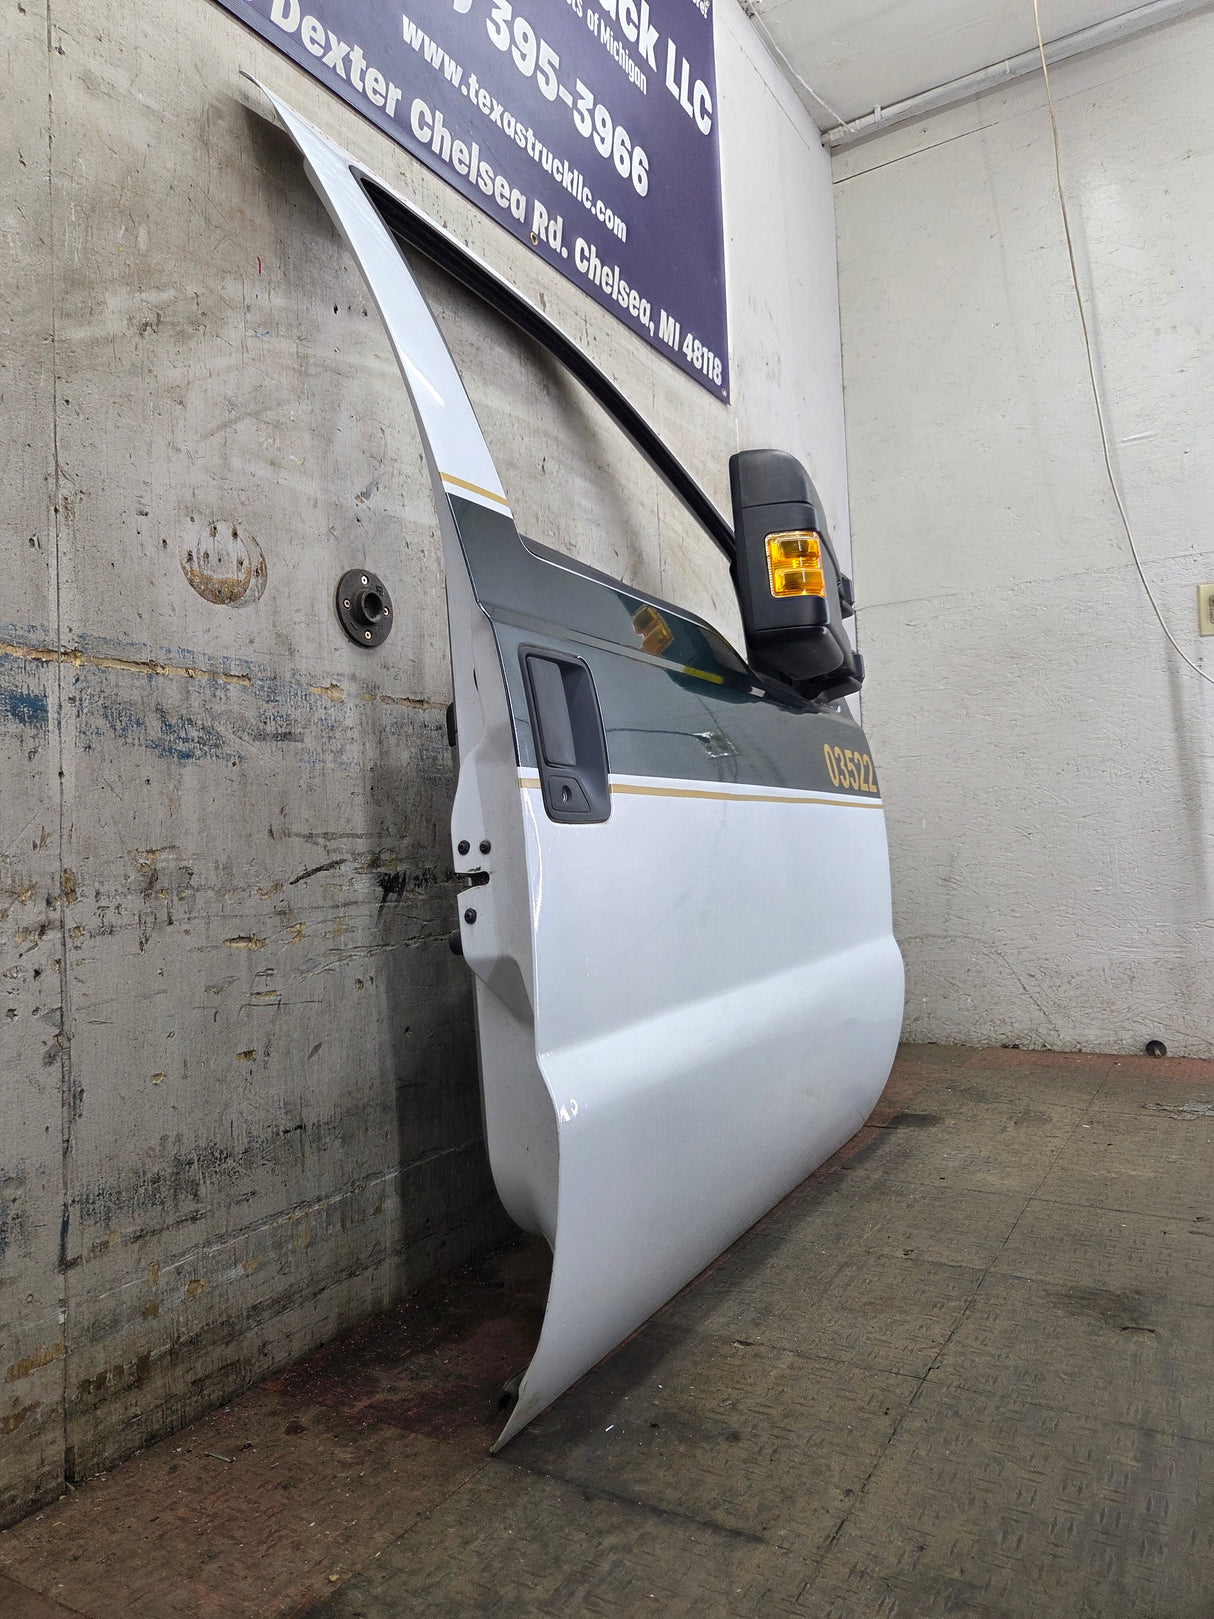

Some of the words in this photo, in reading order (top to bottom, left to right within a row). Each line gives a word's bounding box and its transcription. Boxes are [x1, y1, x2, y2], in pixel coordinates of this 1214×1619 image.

[486, 0, 649, 197] 395-3966
[587, 9, 599, 37] of
[601, 19, 647, 95] Michigan
[666, 38, 712, 135] LLC
[270, 0, 401, 118] Dexter
[410, 98, 527, 223] Chelsea
[532, 199, 568, 259] Rd.
[575, 237, 655, 336] Chelsea,
[658, 309, 681, 352] MI
[682, 333, 722, 386] 48118
[402, 14, 627, 243] www.texastruckllc.com
[823, 743, 877, 793] 03522
